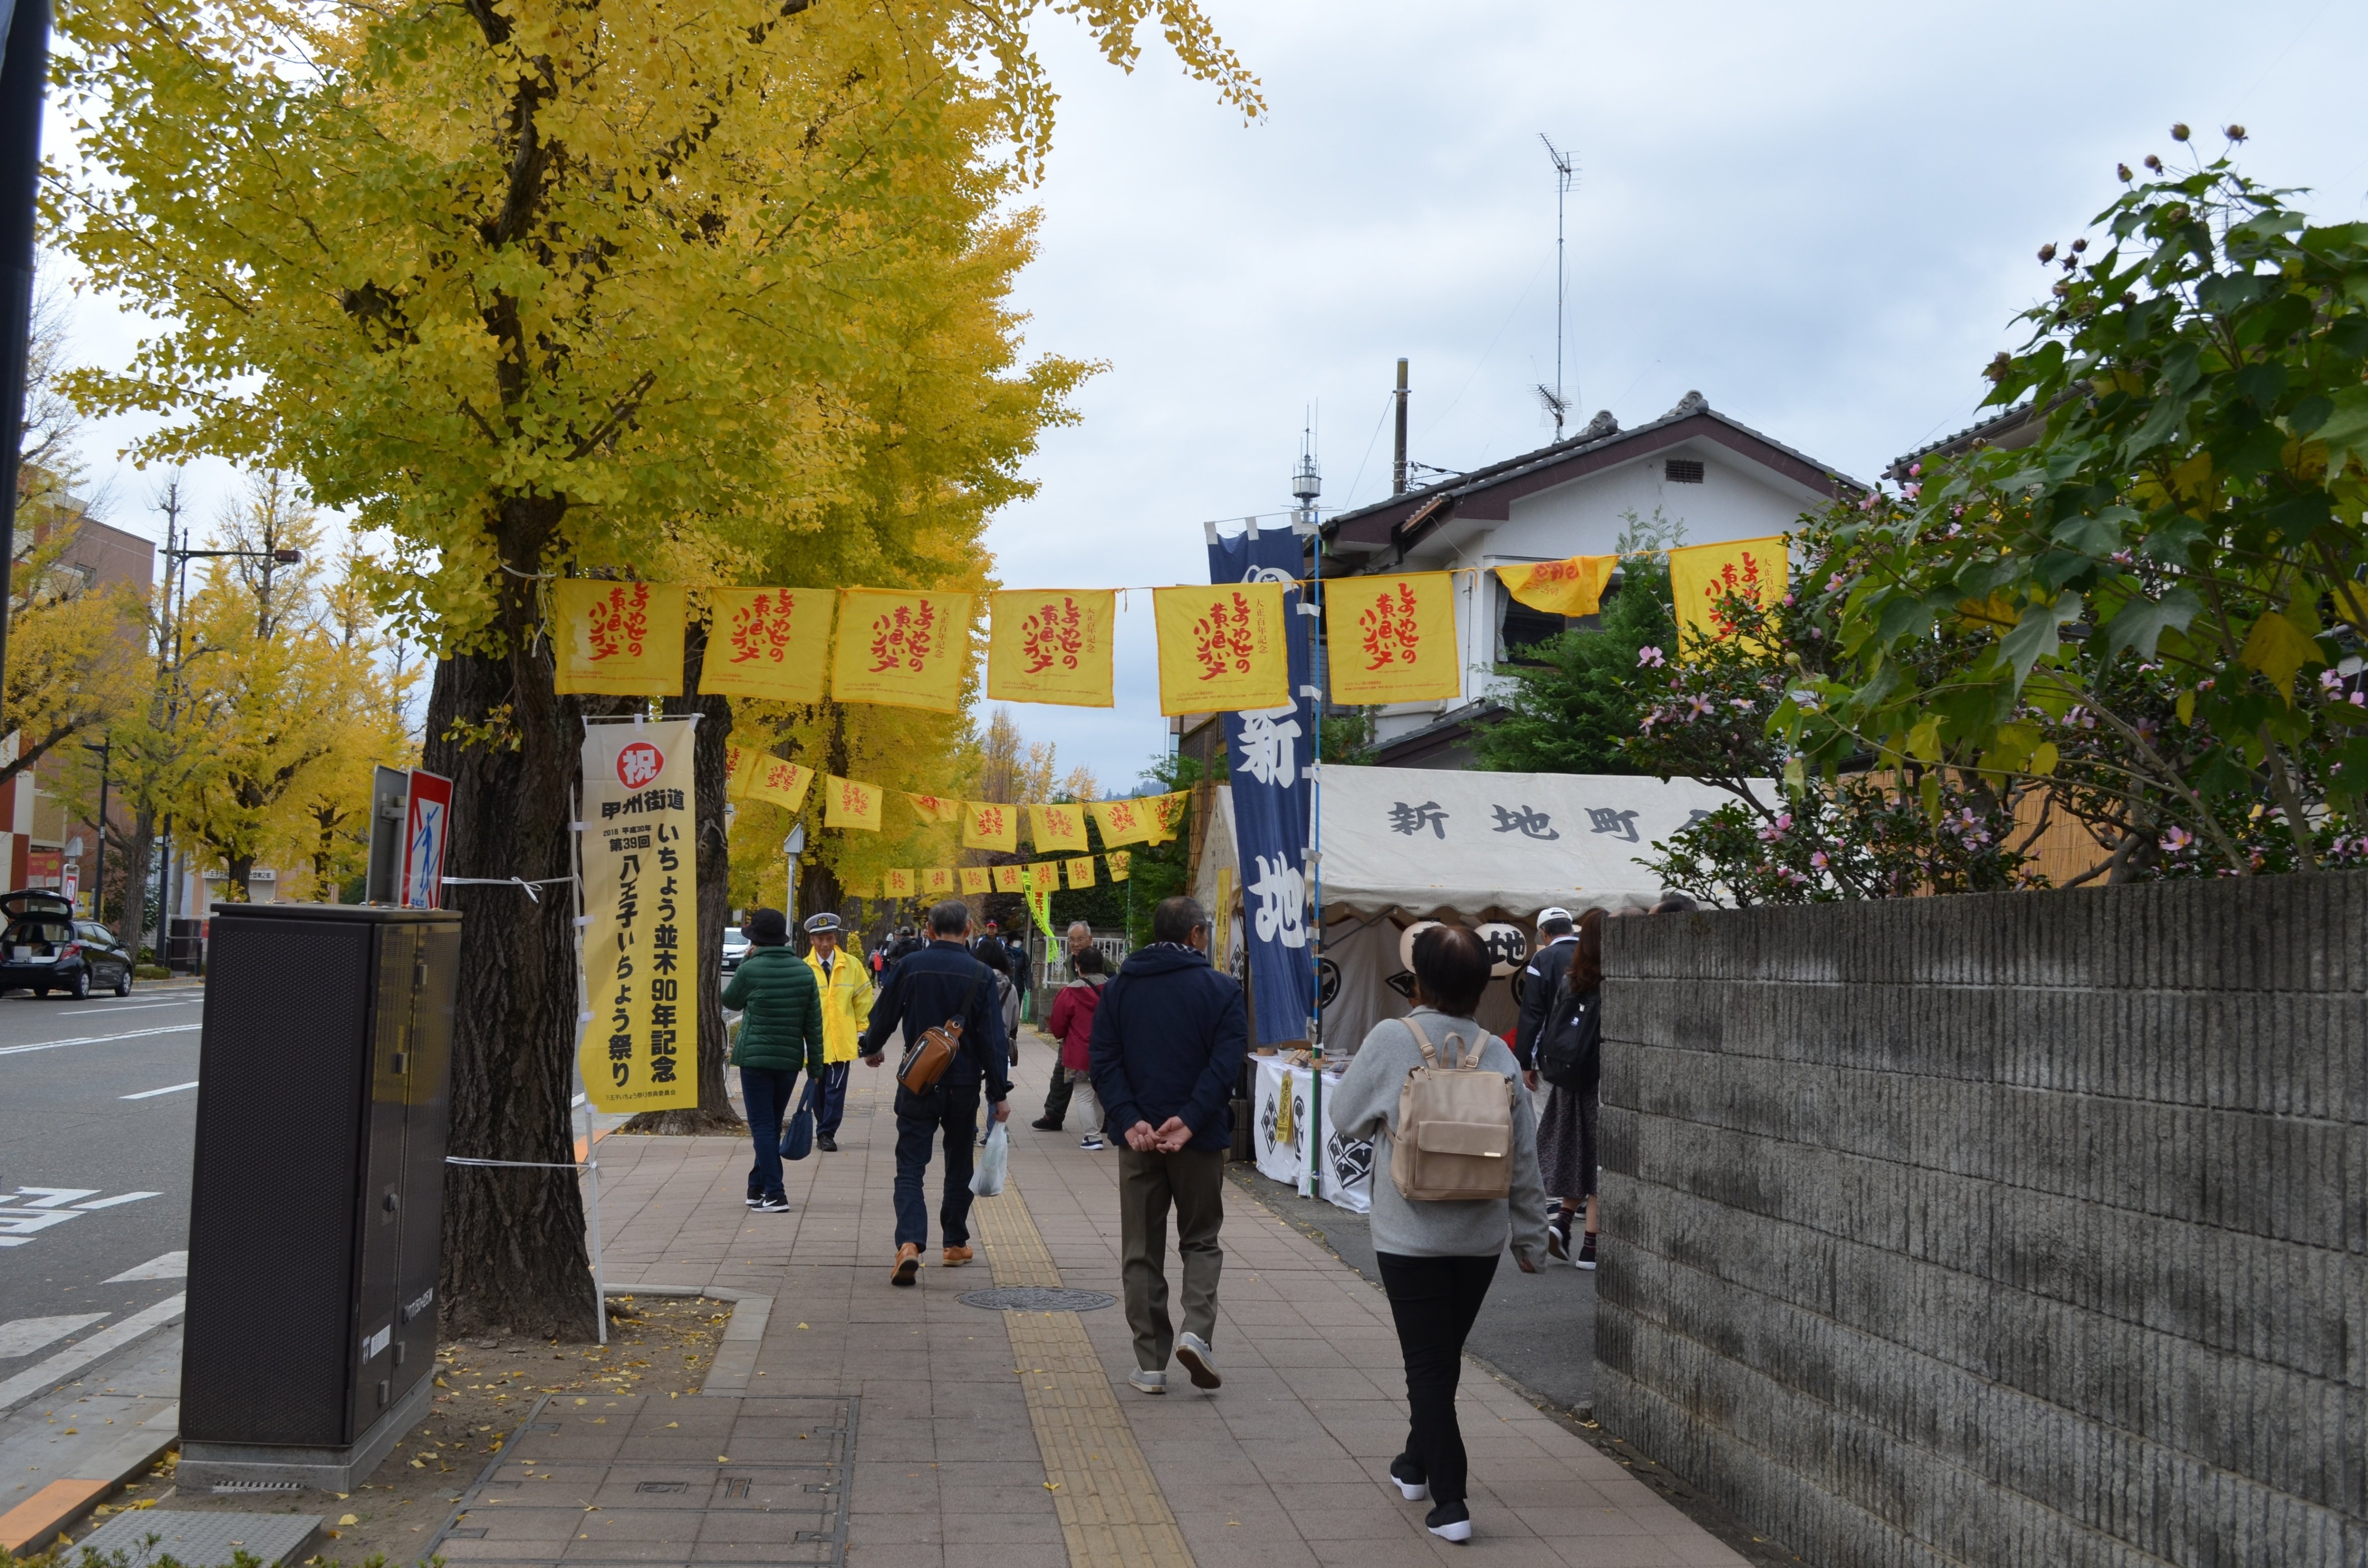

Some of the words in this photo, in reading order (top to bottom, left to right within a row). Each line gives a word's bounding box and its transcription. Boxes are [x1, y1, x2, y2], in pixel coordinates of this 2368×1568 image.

[1741, 552, 1764, 631] しあわ
[1763, 558, 1777, 603] 大正百年
[588, 602, 619, 661] ハンカチ
[607, 587, 626, 642] 黄色い
[623, 582, 650, 657] しあわせの
[729, 607, 760, 663] ハンカチ
[749, 594, 771, 645] 黄色い
[765, 589, 795, 663] しあわせの
[889, 606, 912, 655] 黄色い
[906, 599, 935, 672] しあわせの
[934, 607, 949, 658] 大正百年記念
[1040, 604, 1059, 652] 黄色い
[1056, 597, 1082, 669] しあわせの
[1087, 607, 1096, 653] 大正百年記念
[1210, 602, 1230, 659] 黄色い
[1227, 592, 1254, 673] しあわせの
[1255, 599, 1268, 654] 大正百年記念
[1360, 609, 1394, 670] ハンカチ
[1376, 593, 1397, 649] 黄色い
[1394, 583, 1419, 664] しあわせの
[868, 615, 899, 672] ハンカチ
[1022, 615, 1053, 674] ハンカチ
[1194, 619, 1228, 680] ハンカチ
[623, 750, 657, 785] 祝
[601, 788, 685, 820] 甲州街道
[603, 829, 619, 837] 2018
[622, 824, 652, 835] 平成30年
[1237, 696, 1305, 948] 新地
[609, 835, 651, 852] 第39回
[608, 856, 641, 1087] 八王子いちょう祭り
[651, 823, 680, 1082] いちょう並木90年記念
